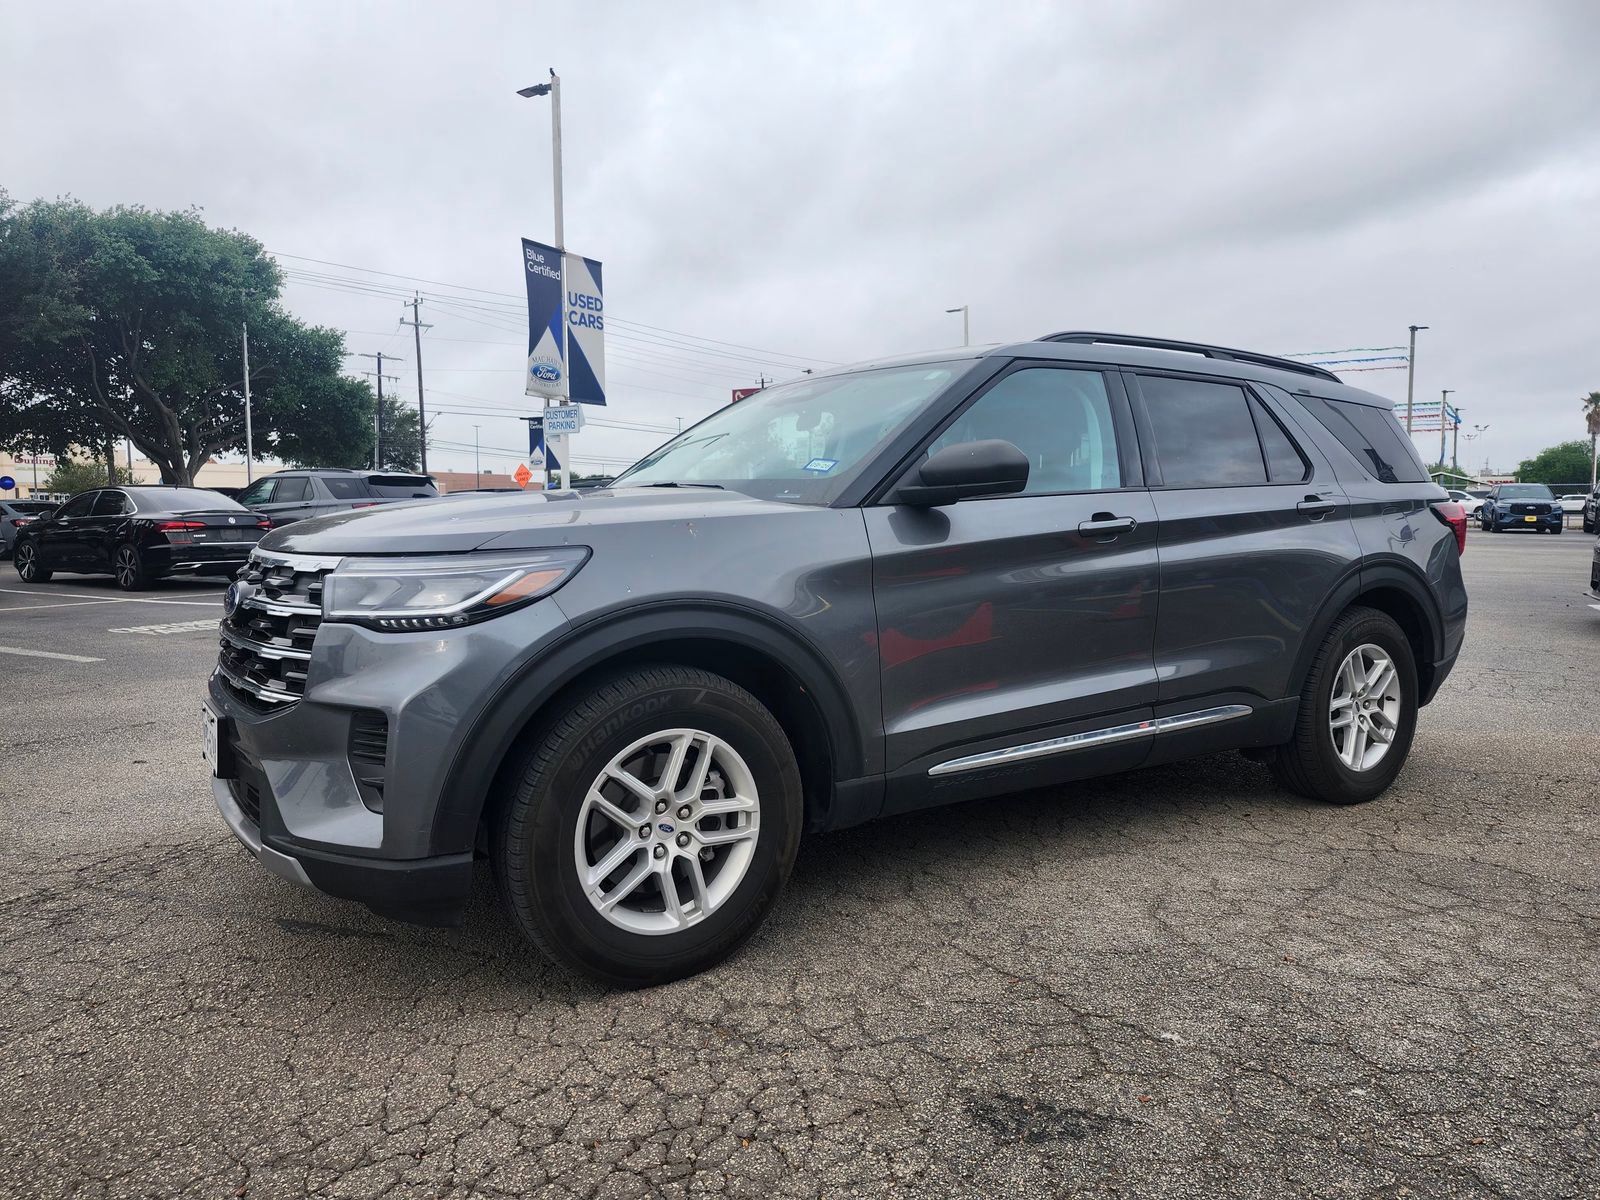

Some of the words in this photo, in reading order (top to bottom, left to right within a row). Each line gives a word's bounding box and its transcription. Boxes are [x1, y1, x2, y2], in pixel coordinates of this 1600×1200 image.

[525, 248, 544, 263] Blue
[527, 261, 561, 280] Certified
[568, 291, 603, 312] USED
[568, 310, 604, 330] CARS
[537, 366, 557, 379] Ford
[546, 409, 577, 419] CUSTOMER
[549, 421, 575, 430] PARKING
